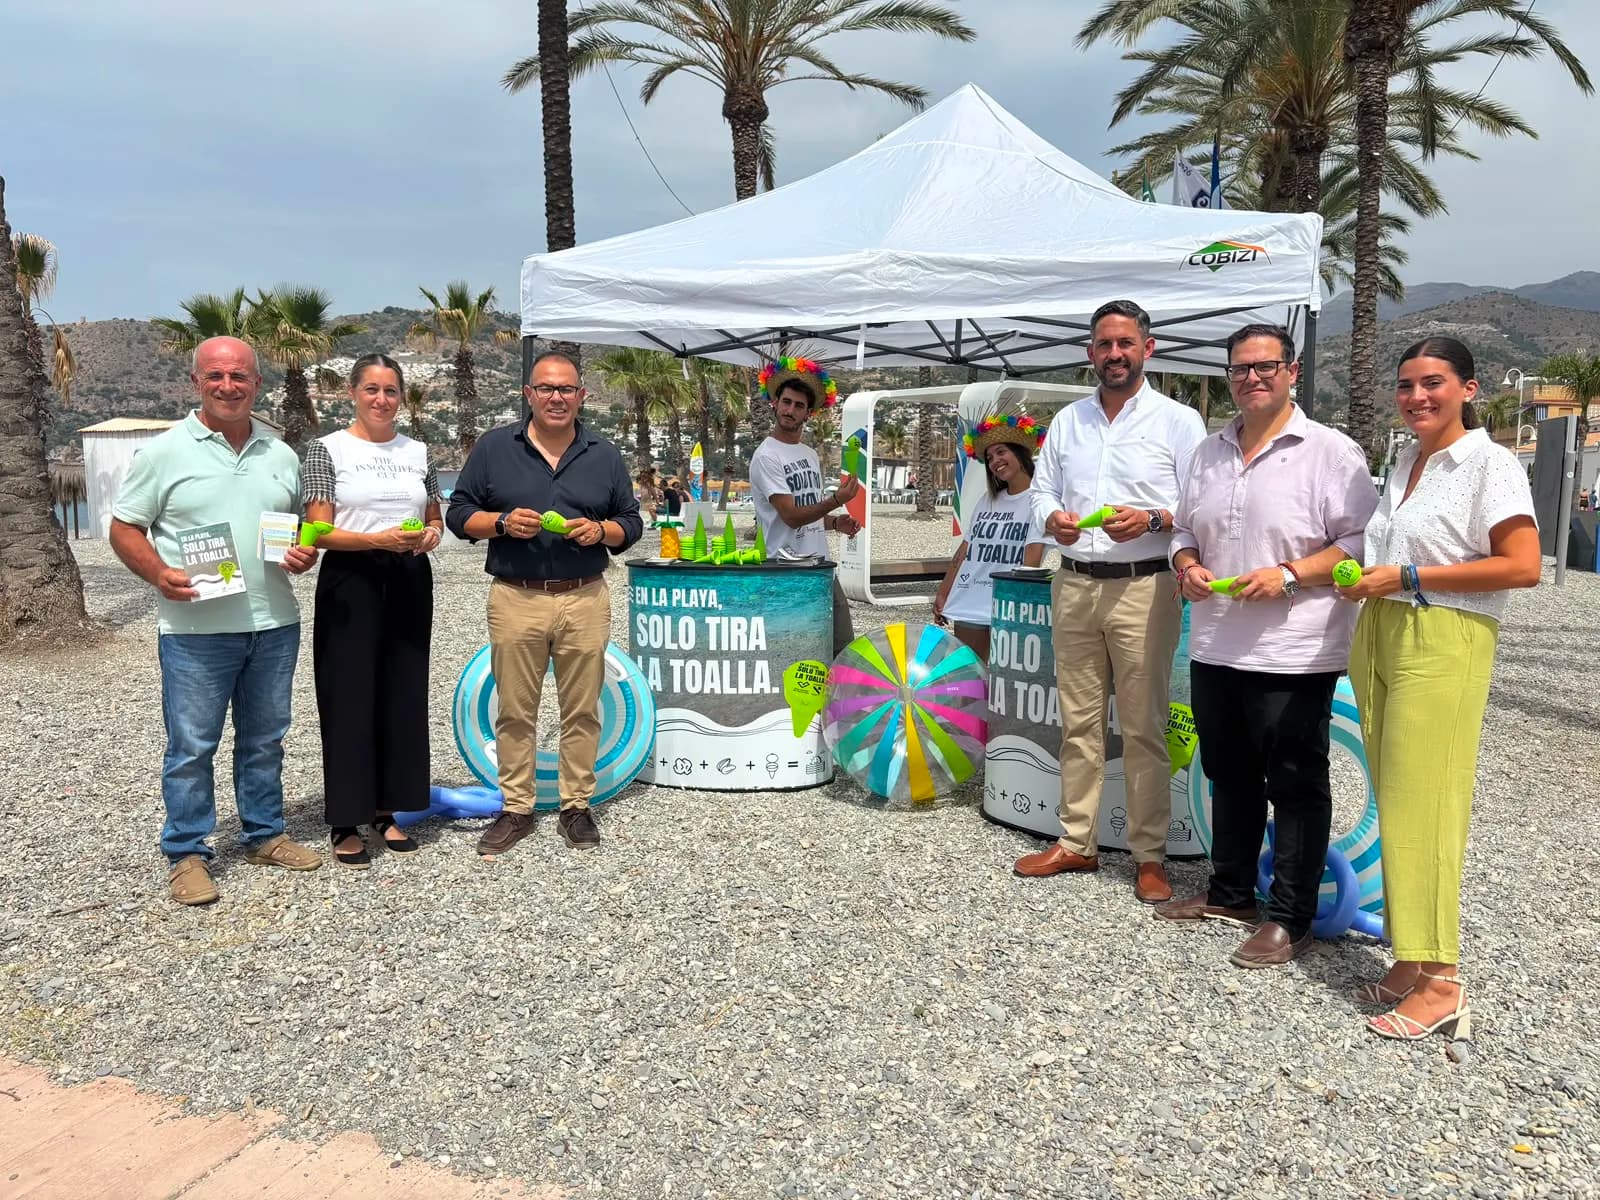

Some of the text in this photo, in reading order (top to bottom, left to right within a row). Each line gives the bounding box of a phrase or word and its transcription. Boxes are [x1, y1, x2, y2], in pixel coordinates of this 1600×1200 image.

[1188, 249, 1258, 266] COBIZI
[182, 536, 227, 554] SOLO TIRA
[185, 548, 233, 566] LA TOALLA.
[635, 586, 723, 610] EN LA PLAYA,
[1001, 599, 1015, 622] LA
[1019, 602, 1053, 627] PLAY
[636, 612, 768, 651] SOLO TIRA
[989, 627, 1041, 673] SOLO
[669, 659, 780, 694] TOALLA.
